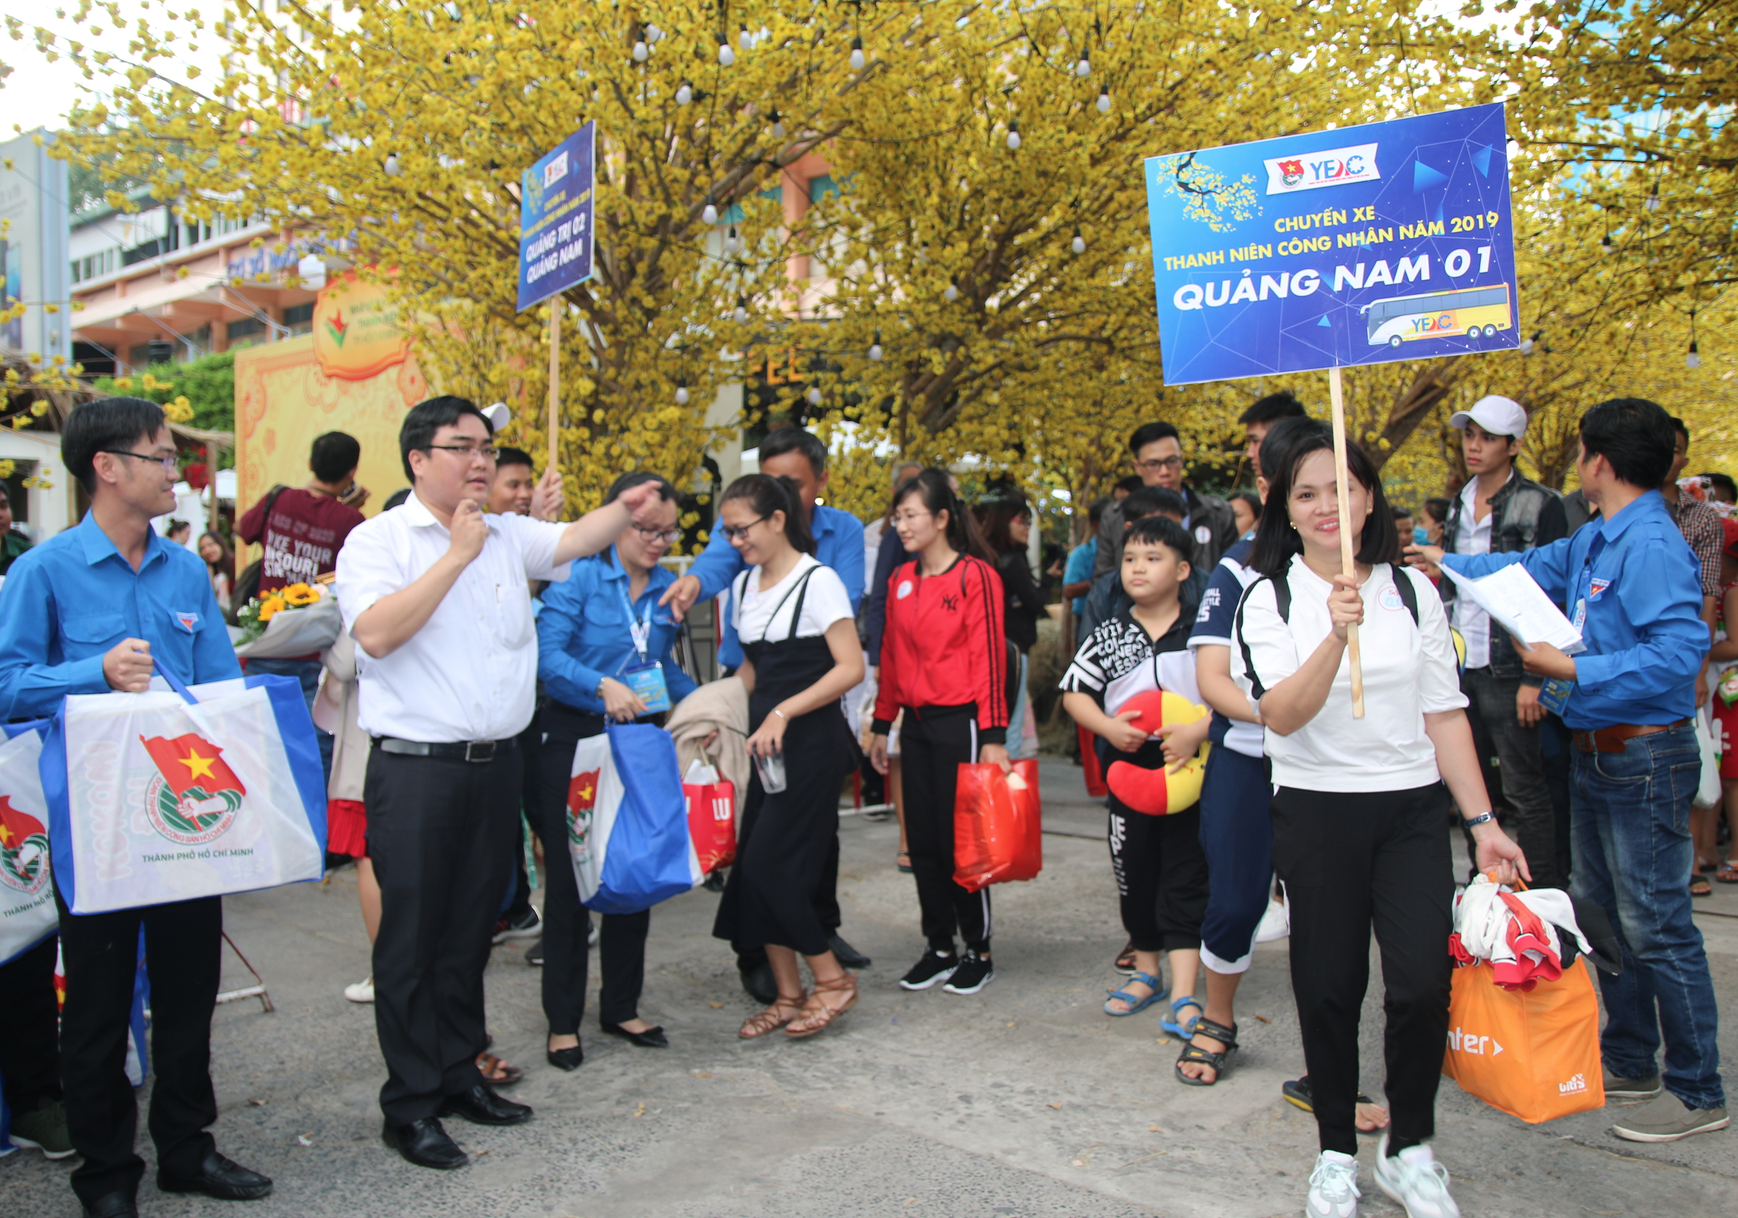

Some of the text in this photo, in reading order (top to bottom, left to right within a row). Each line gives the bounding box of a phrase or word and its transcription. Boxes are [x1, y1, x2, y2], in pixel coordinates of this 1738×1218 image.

[526, 212, 586, 263] QUẢNG TRỊ 02
[1274, 205, 1376, 233] CHUYẾN XE
[1163, 211, 1499, 271] THANH NIÊN CÔNG NHÂN NĂM 2019
[527, 238, 583, 284] QUẢNG NAM
[1172, 245, 1492, 311] QUẢNG NAM 01
[294, 539, 332, 564] YOUR
[712, 797, 731, 821] LU
[142, 852, 174, 863] THÀNH
[229, 848, 254, 857] MINH
